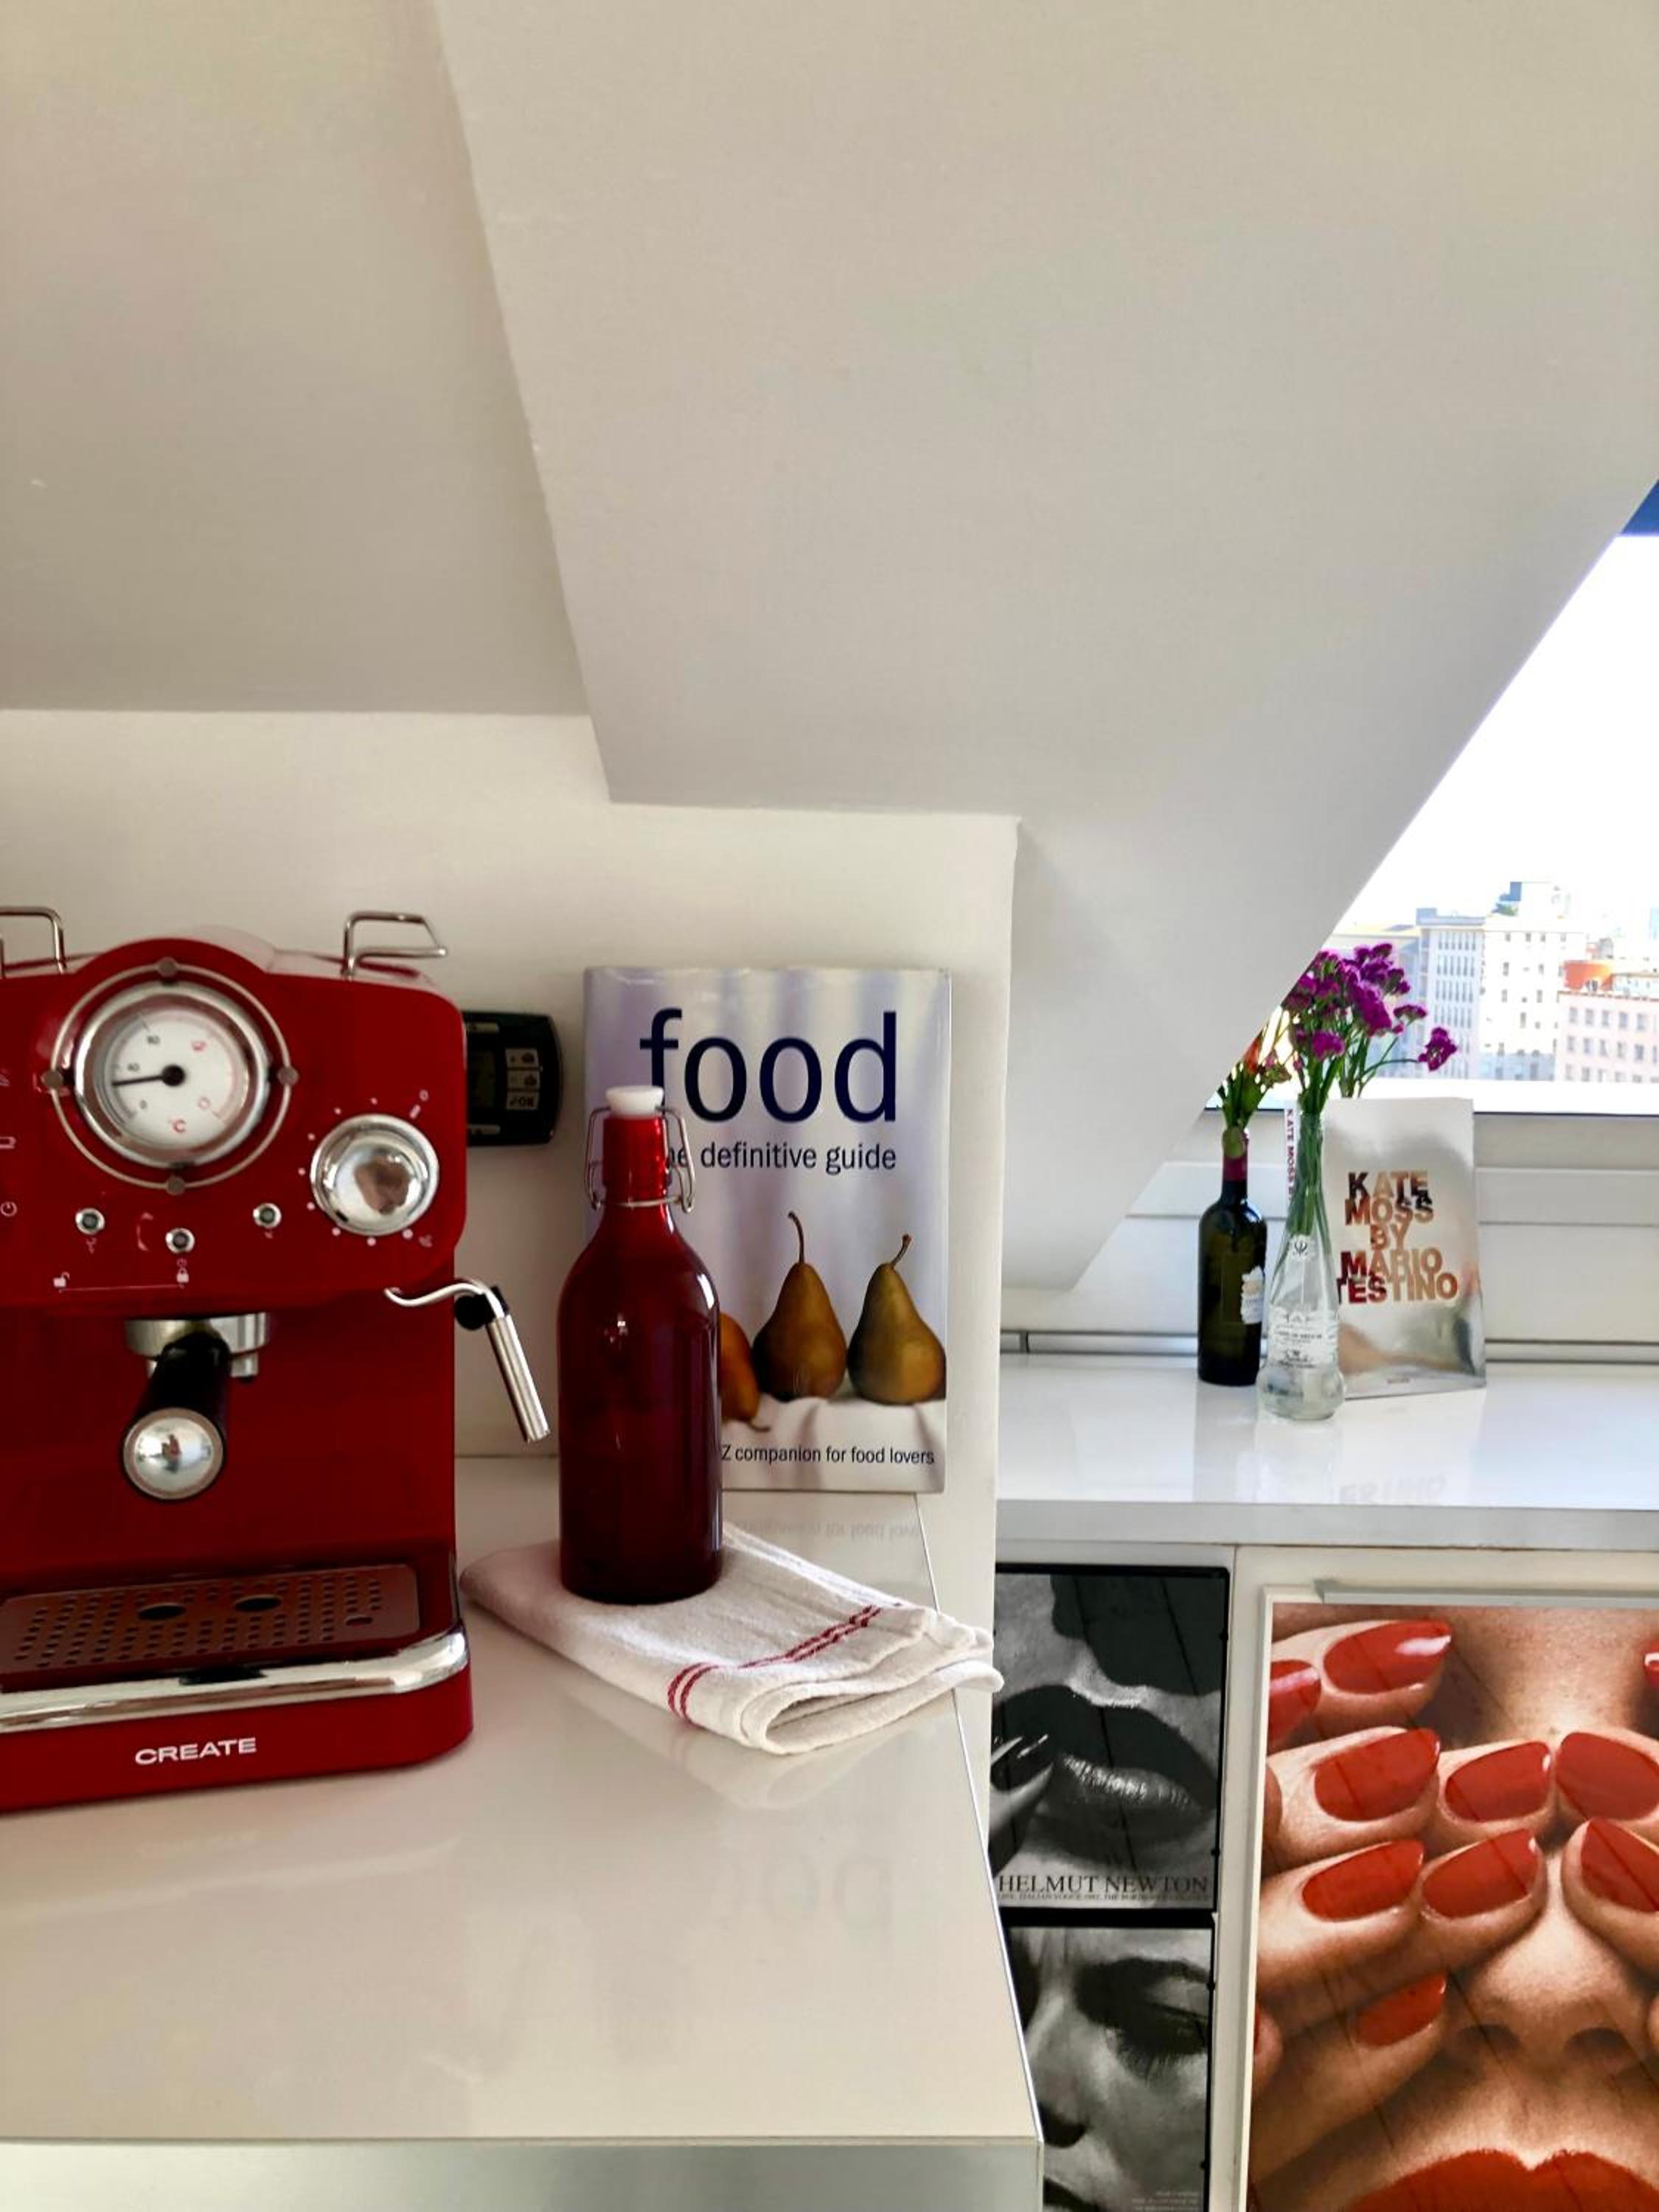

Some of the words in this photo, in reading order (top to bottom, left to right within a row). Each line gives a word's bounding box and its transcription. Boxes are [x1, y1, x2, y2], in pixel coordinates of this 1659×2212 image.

[640, 1008, 896, 1122] food
[700, 1141, 817, 1169] definitive
[825, 1144, 897, 1175] guide
[1348, 1171, 1430, 1202] KATE
[1345, 1196, 1434, 1225] MOSS
[1370, 1220, 1413, 1251] BY
[1340, 1248, 1443, 1283] MARIO
[1337, 1273, 1459, 1304] TESTINO
[735, 1445, 821, 1465] companion
[827, 1446, 847, 1463] for
[851, 1447, 885, 1464] food
[890, 1447, 935, 1465] lovers
[135, 1736, 257, 1765] CREATE
[998, 1875, 1099, 1893] HELMUT
[1105, 1875, 1208, 1893] NEWTON
